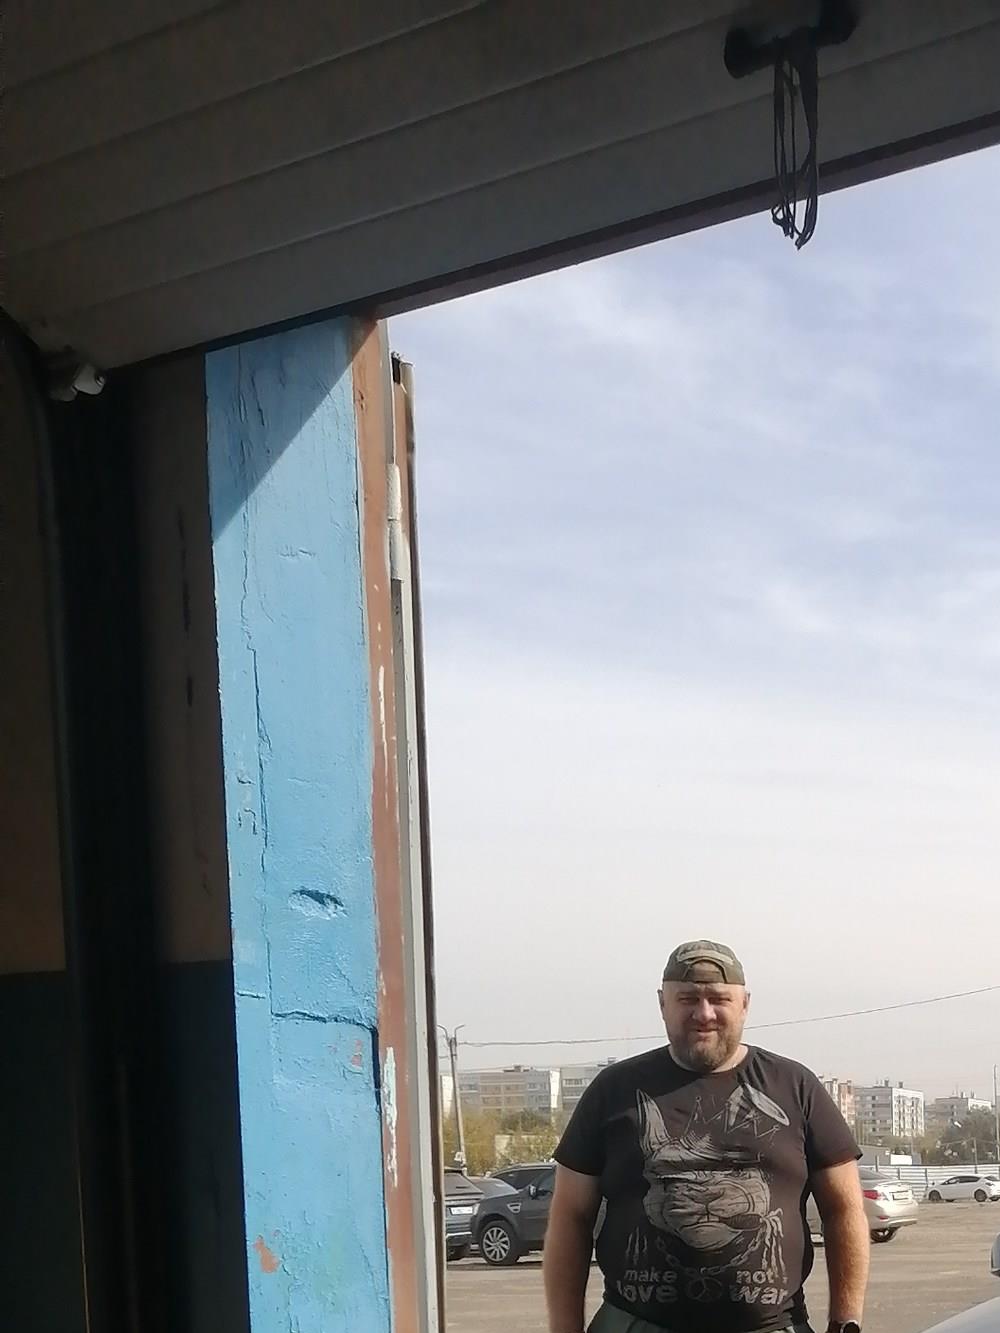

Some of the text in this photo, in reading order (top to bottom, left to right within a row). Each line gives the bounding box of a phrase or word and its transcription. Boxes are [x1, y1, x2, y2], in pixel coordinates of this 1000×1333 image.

[623, 1266, 678, 1283] make
[736, 1269, 775, 1284] not
[616, 1280, 679, 1303] love
[729, 1284, 789, 1305] war
